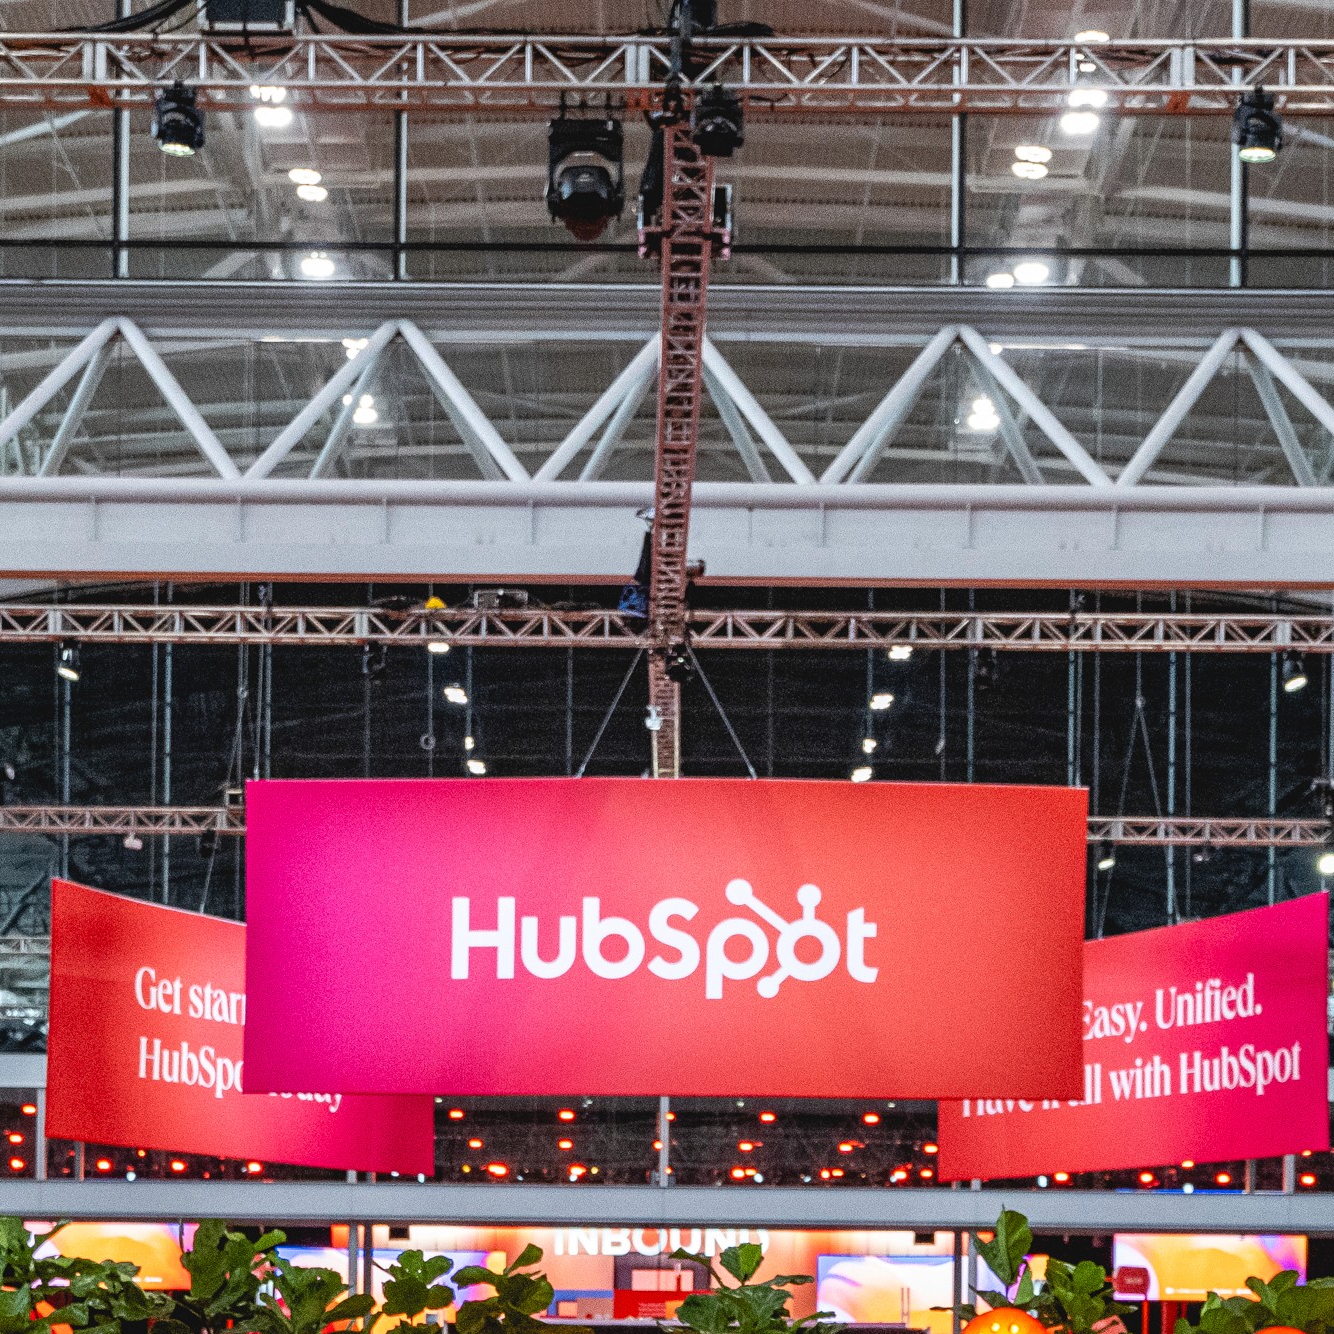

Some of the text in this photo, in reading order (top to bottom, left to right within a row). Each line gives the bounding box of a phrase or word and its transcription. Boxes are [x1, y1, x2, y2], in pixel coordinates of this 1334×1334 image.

[451, 878, 879, 1000] HubSpot
[134, 966, 246, 1026] Get star
[1083, 972, 1263, 1043] Easy. Unified.
[1109, 1054, 1171, 1101] with
[1178, 1040, 1302, 1096] HubSpot
[554, 1229, 770, 1257] INBOUND
